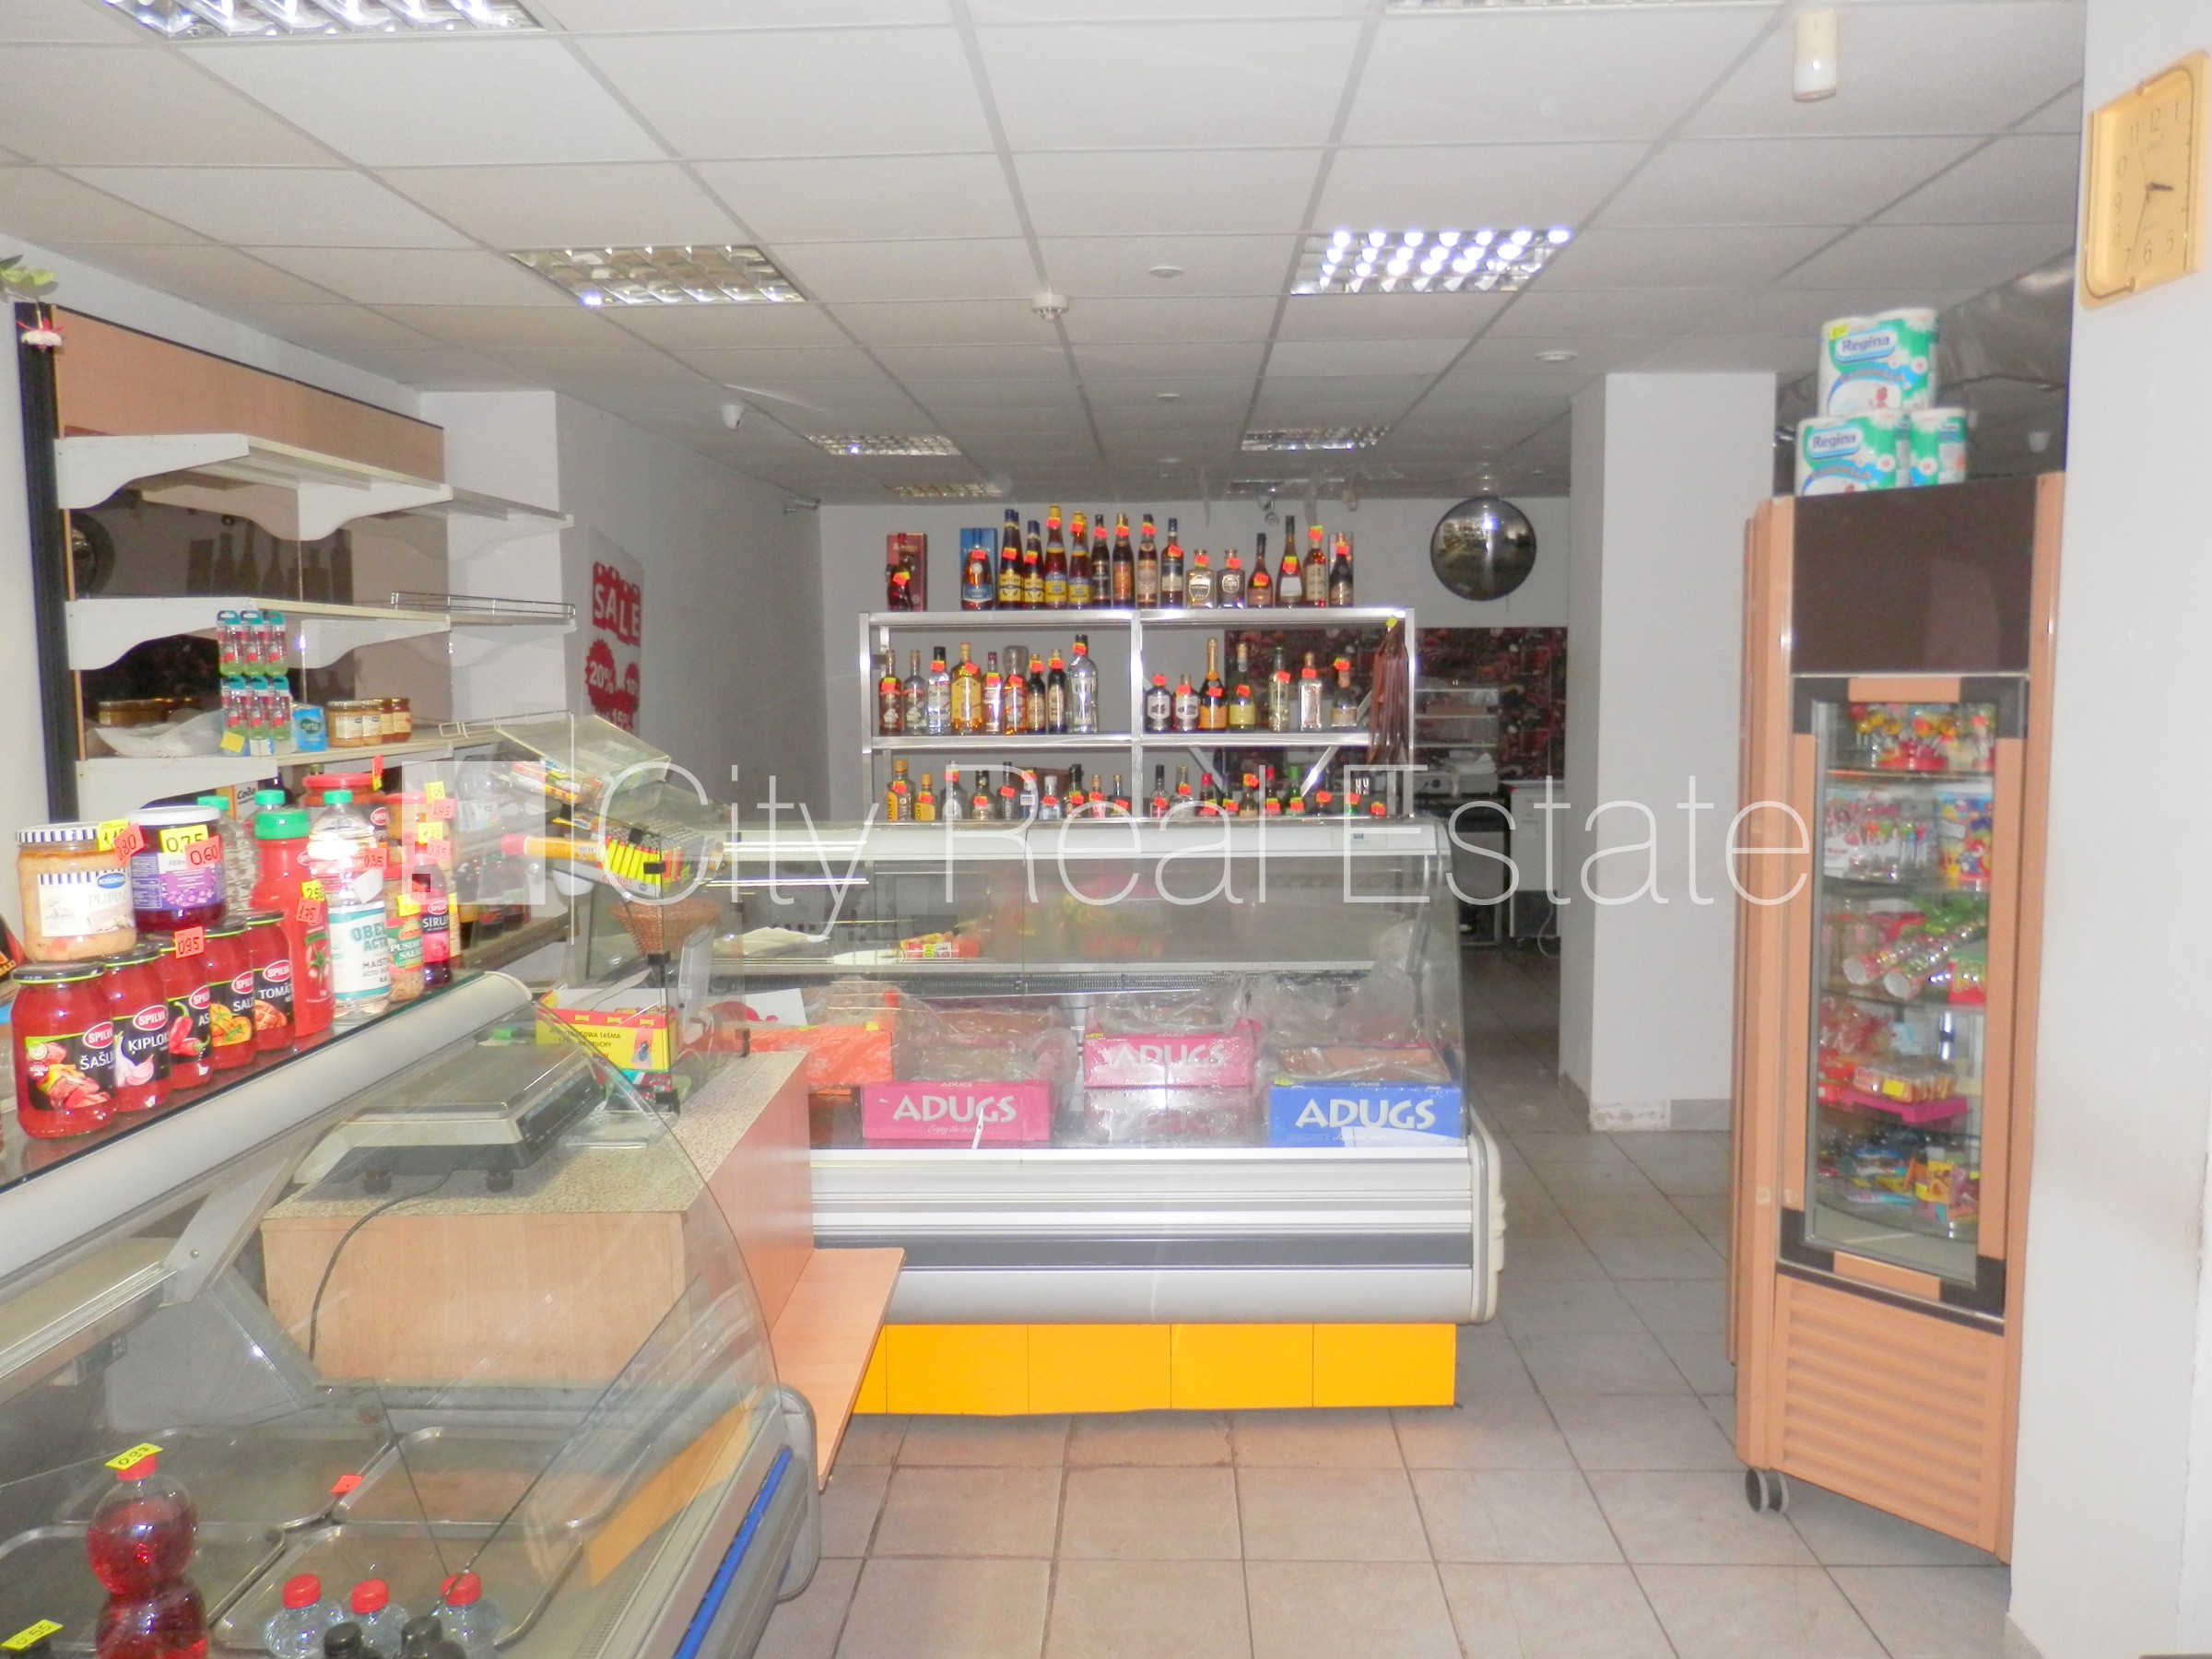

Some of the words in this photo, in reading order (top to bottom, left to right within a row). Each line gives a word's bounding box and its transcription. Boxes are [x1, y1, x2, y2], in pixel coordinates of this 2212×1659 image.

[1841, 335, 1889, 353] Regina
[1811, 433, 1856, 450] Regina
[594, 582, 641, 639] SALE
[589, 660, 615, 695] 20%
[1111, 1043, 1227, 1068] ADUGS
[892, 1094, 1018, 1124] ADUGS
[1295, 1098, 1436, 1130] ADUGS
